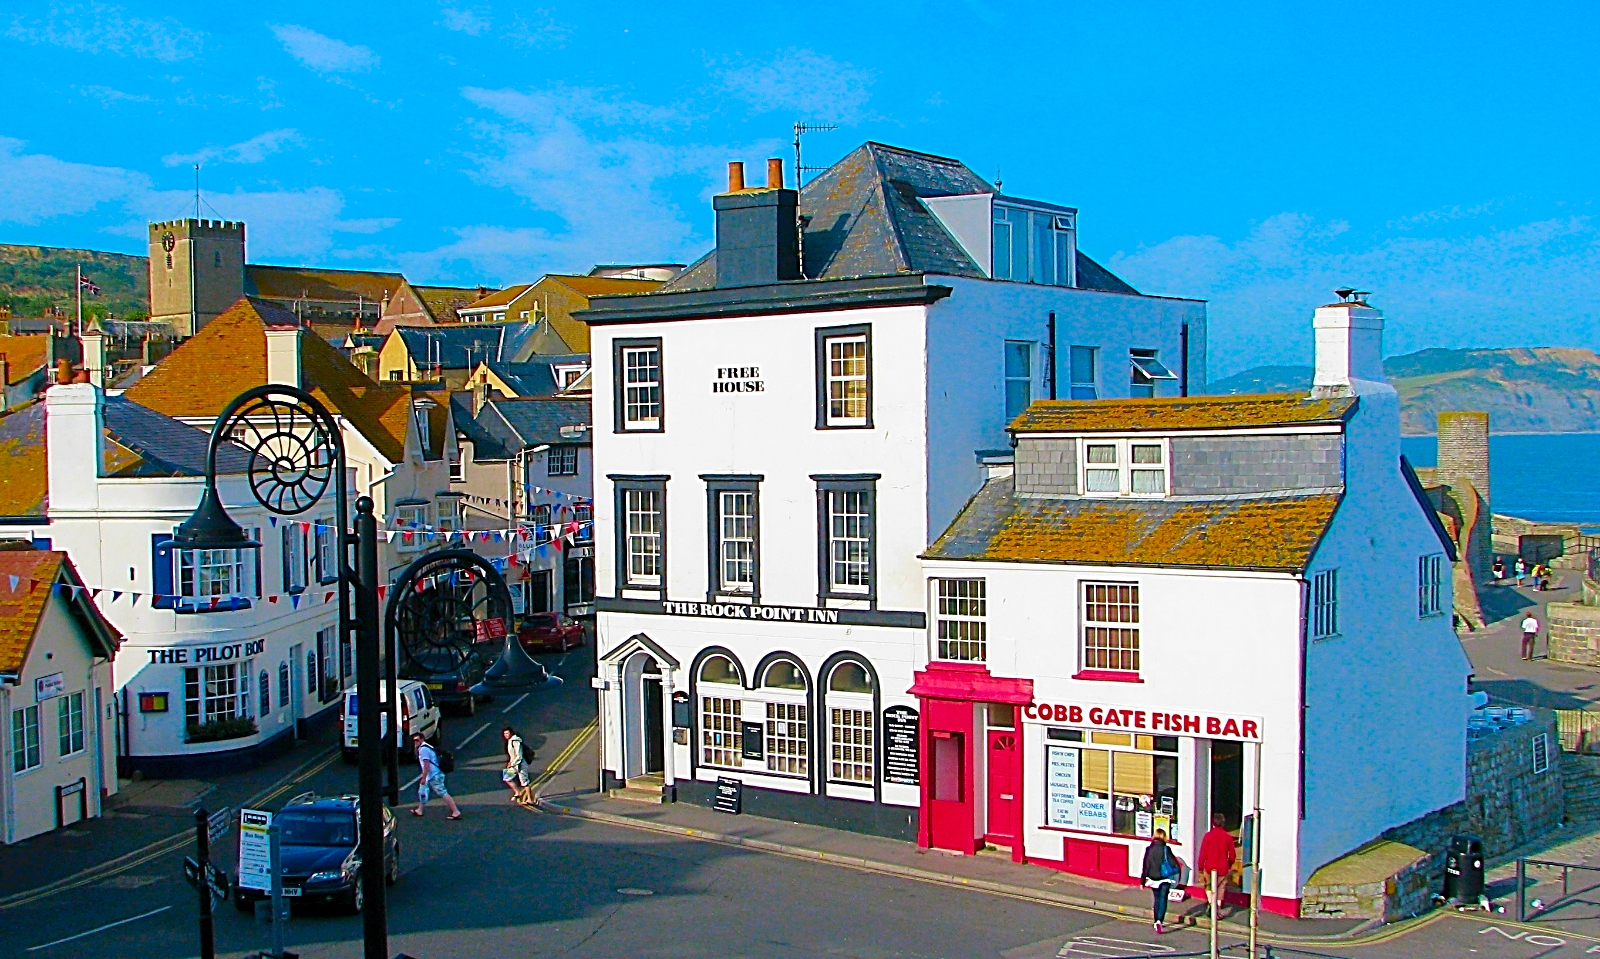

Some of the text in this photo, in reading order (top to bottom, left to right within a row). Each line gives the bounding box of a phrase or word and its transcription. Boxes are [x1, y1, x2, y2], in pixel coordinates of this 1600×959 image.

[717, 367, 760, 379] FREE
[712, 380, 765, 393] HOUSE
[662, 601, 839, 623] THE ROCK POINT INN
[147, 639, 265, 664] THE PILOT BOAT
[1024, 703, 1259, 739] COBB GATE FISH BAR
[1081, 801, 1105, 810] DONER
[1079, 809, 1108, 819] KEBABS
[1478, 926, 1567, 946] NO
